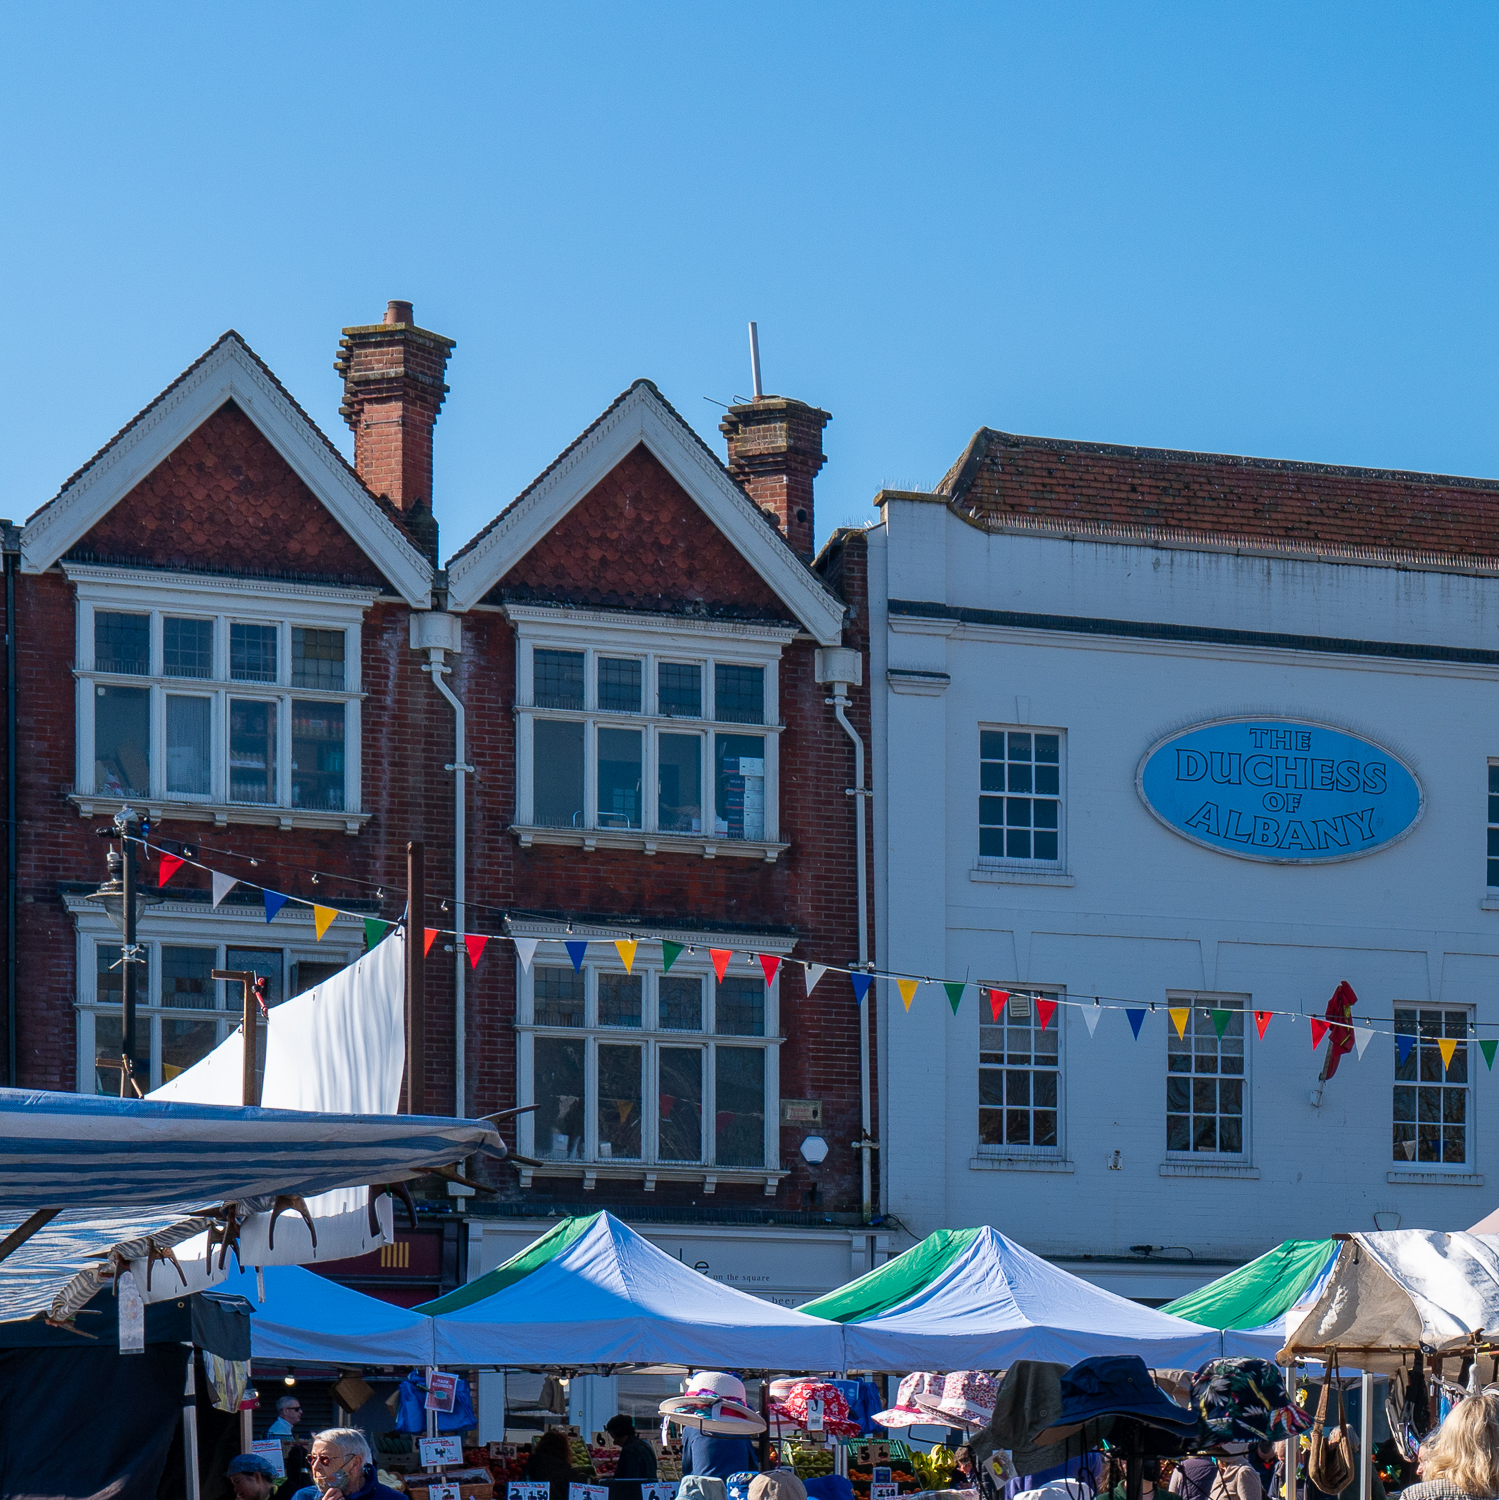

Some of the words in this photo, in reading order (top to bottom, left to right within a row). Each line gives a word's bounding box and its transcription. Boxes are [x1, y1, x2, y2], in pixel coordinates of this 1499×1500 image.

[1249, 727, 1312, 751] THE
[1175, 748, 1388, 795] DUCHESS
[1262, 791, 1303, 814] OF
[1184, 800, 1376, 851] ALBANY
[726, 1273, 739, 1281] the
[742, 1275, 771, 1283] square
[771, 1296, 797, 1305] beer
